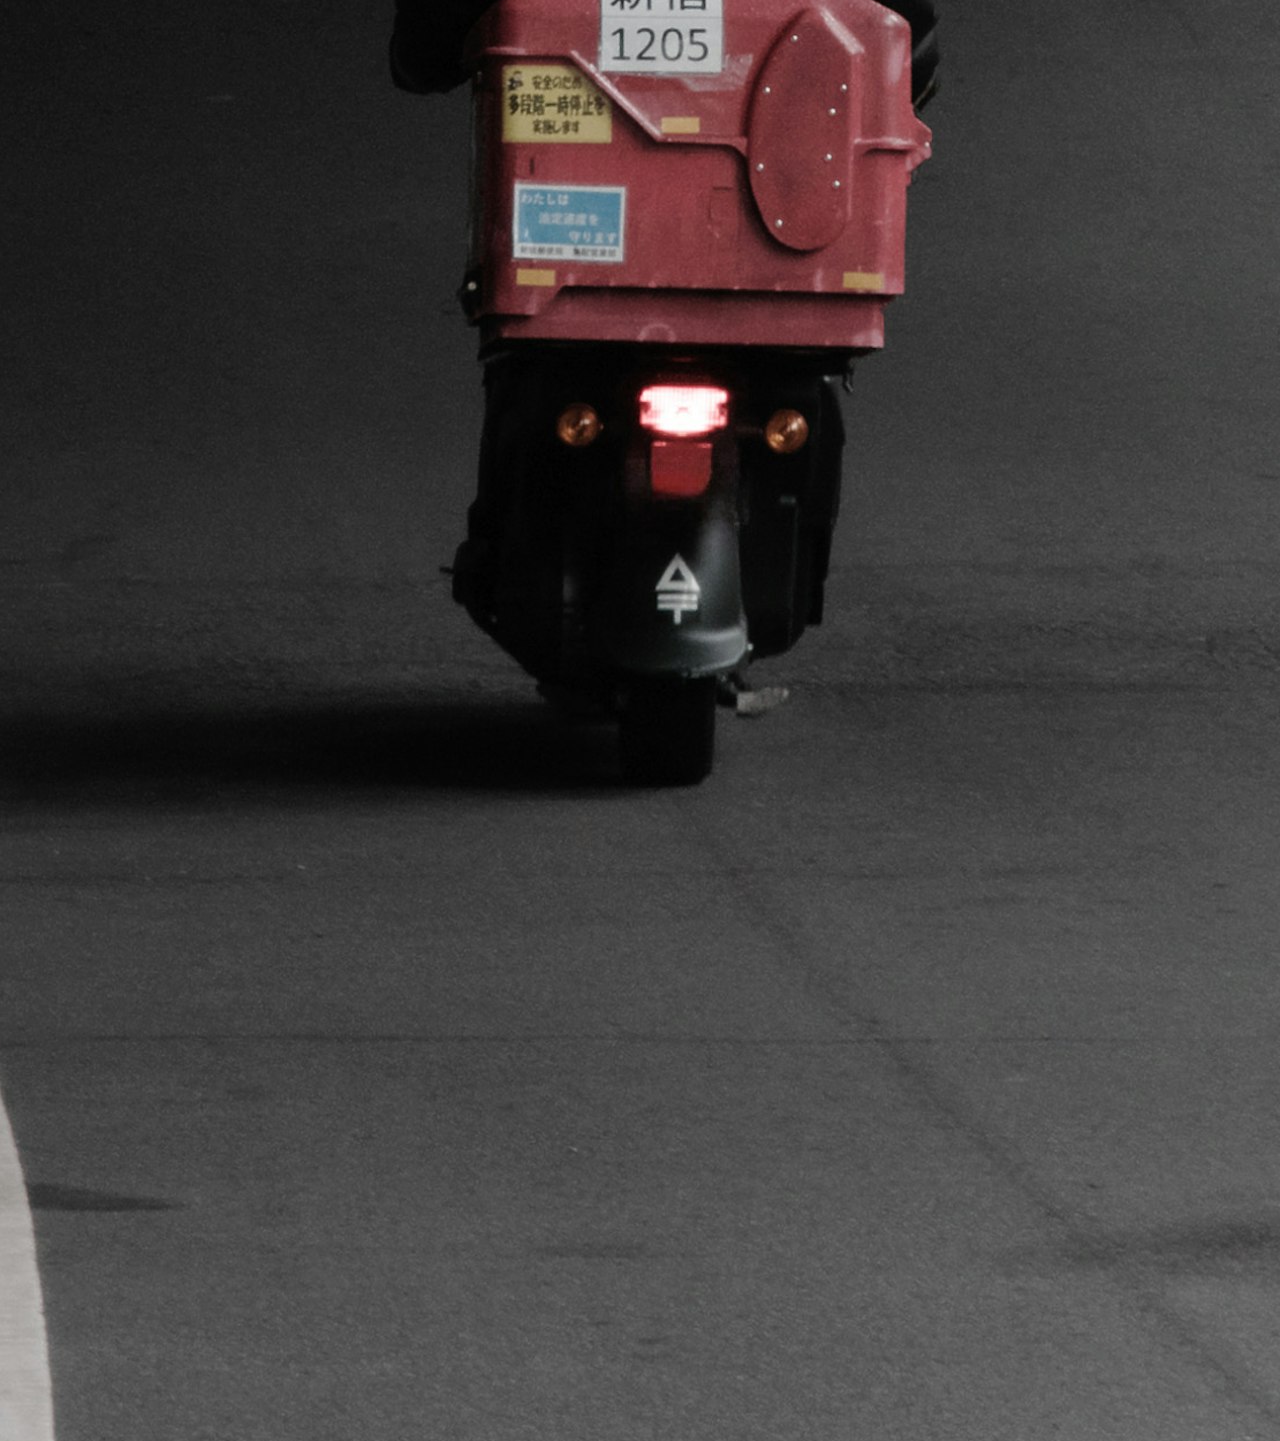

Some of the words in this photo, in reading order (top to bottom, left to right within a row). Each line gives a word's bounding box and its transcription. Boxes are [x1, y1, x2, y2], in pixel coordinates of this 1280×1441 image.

[611, 27, 709, 62] 1205
[520, 192, 569, 206] わたしは
